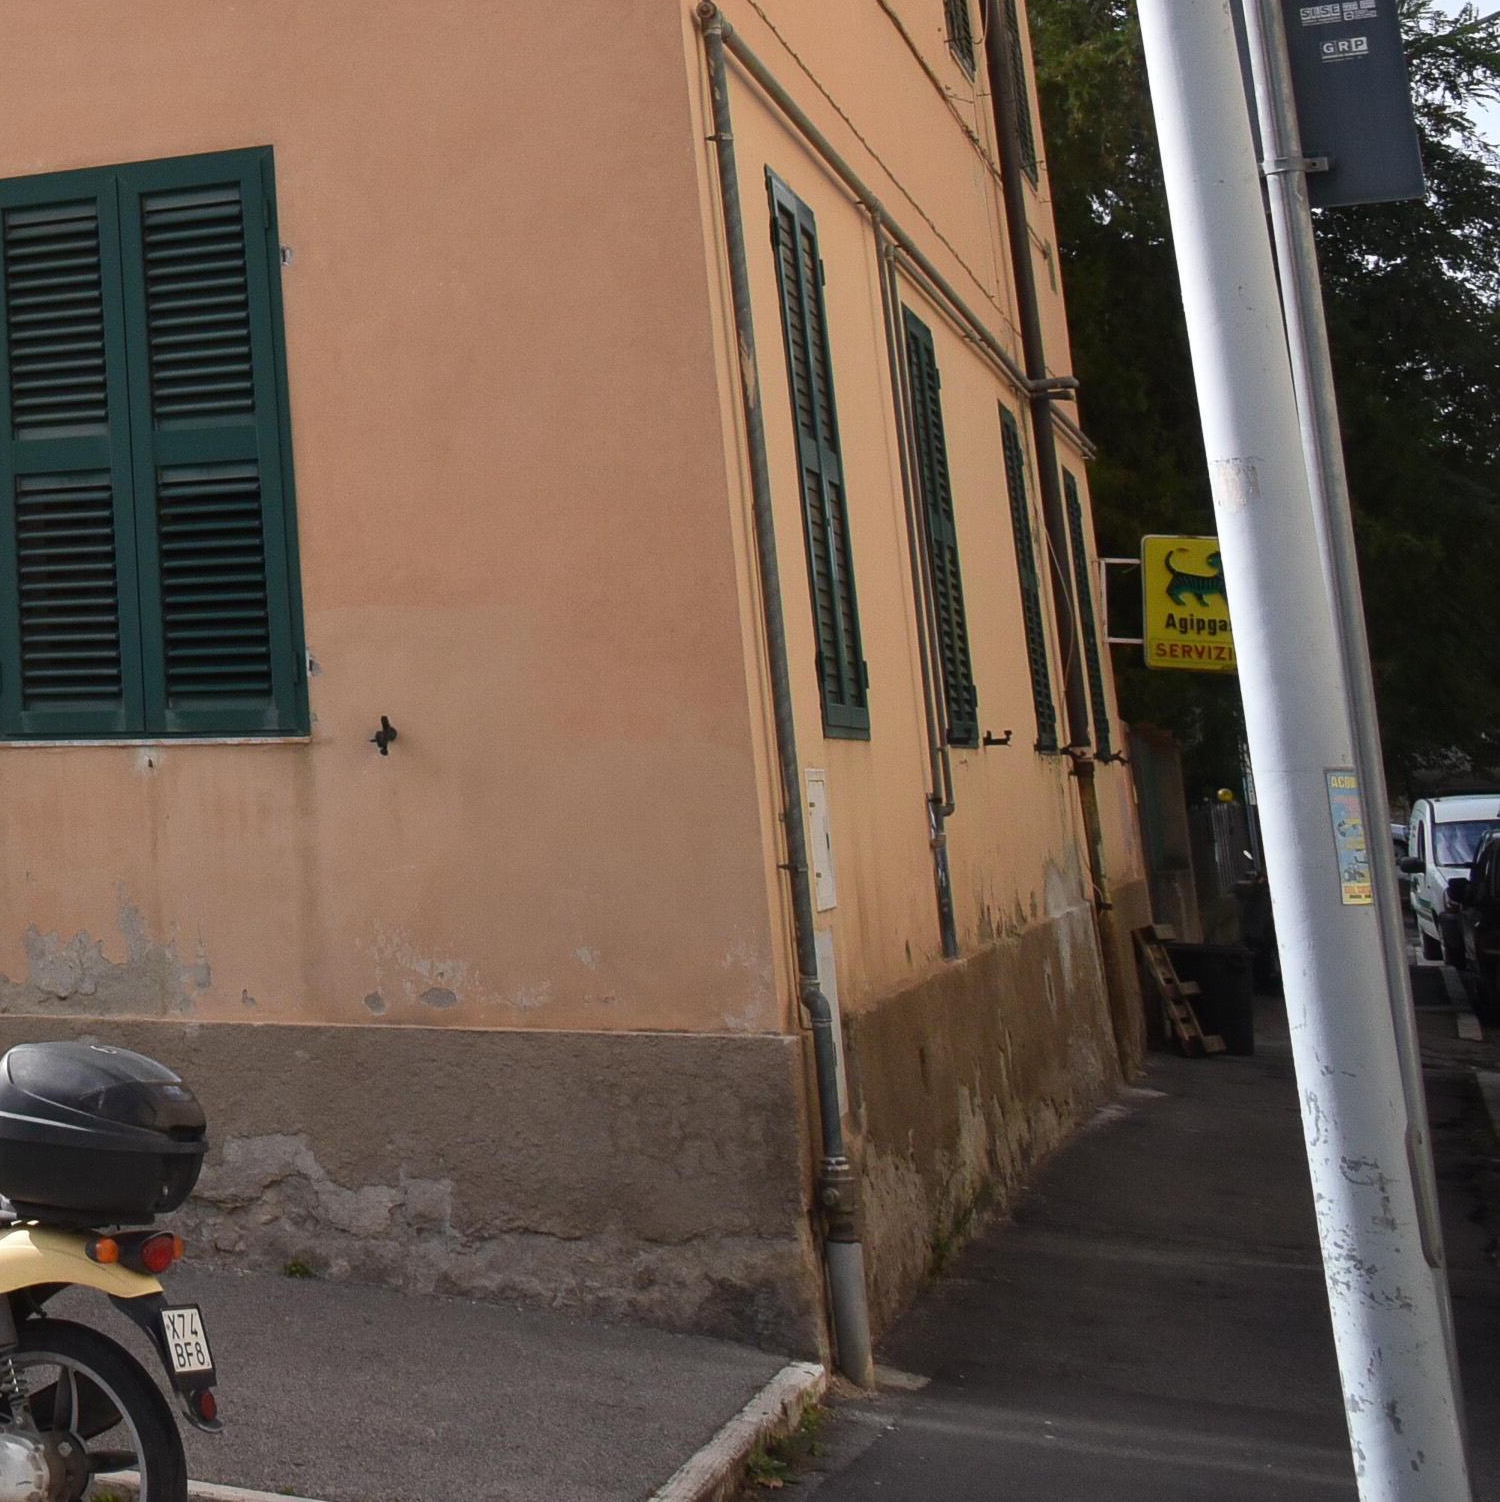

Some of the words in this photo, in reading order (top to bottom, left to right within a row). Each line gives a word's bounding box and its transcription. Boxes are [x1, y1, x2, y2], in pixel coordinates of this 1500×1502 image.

[1322, 39, 1365, 54] GRP
[1165, 613, 1232, 635] Agipga
[168, 1314, 198, 1339] X74
[174, 1342, 205, 1368] BF8
